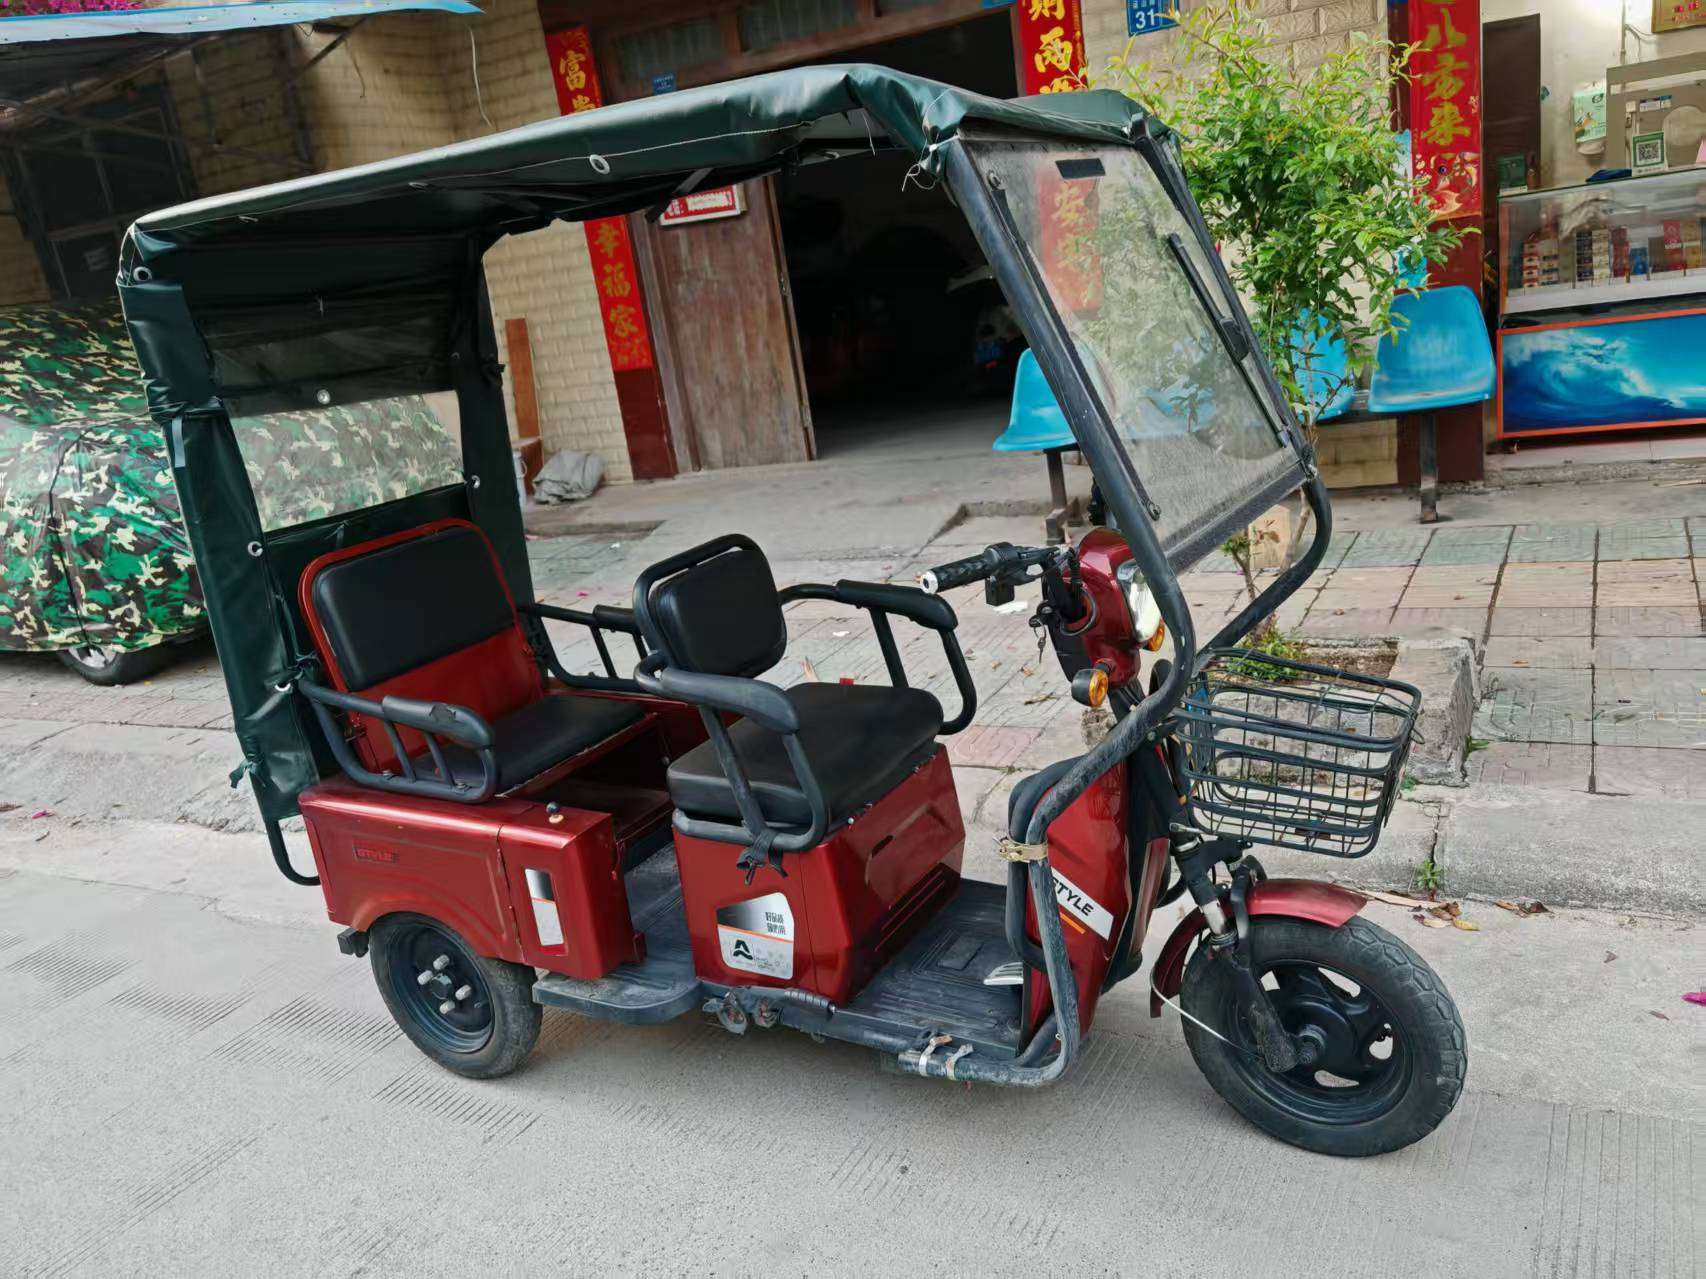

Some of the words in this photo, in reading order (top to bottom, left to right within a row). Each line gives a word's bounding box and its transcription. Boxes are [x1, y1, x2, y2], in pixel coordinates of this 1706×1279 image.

[1135, 8, 1156, 29] 31
[595, 223, 639, 337] 幸福家
